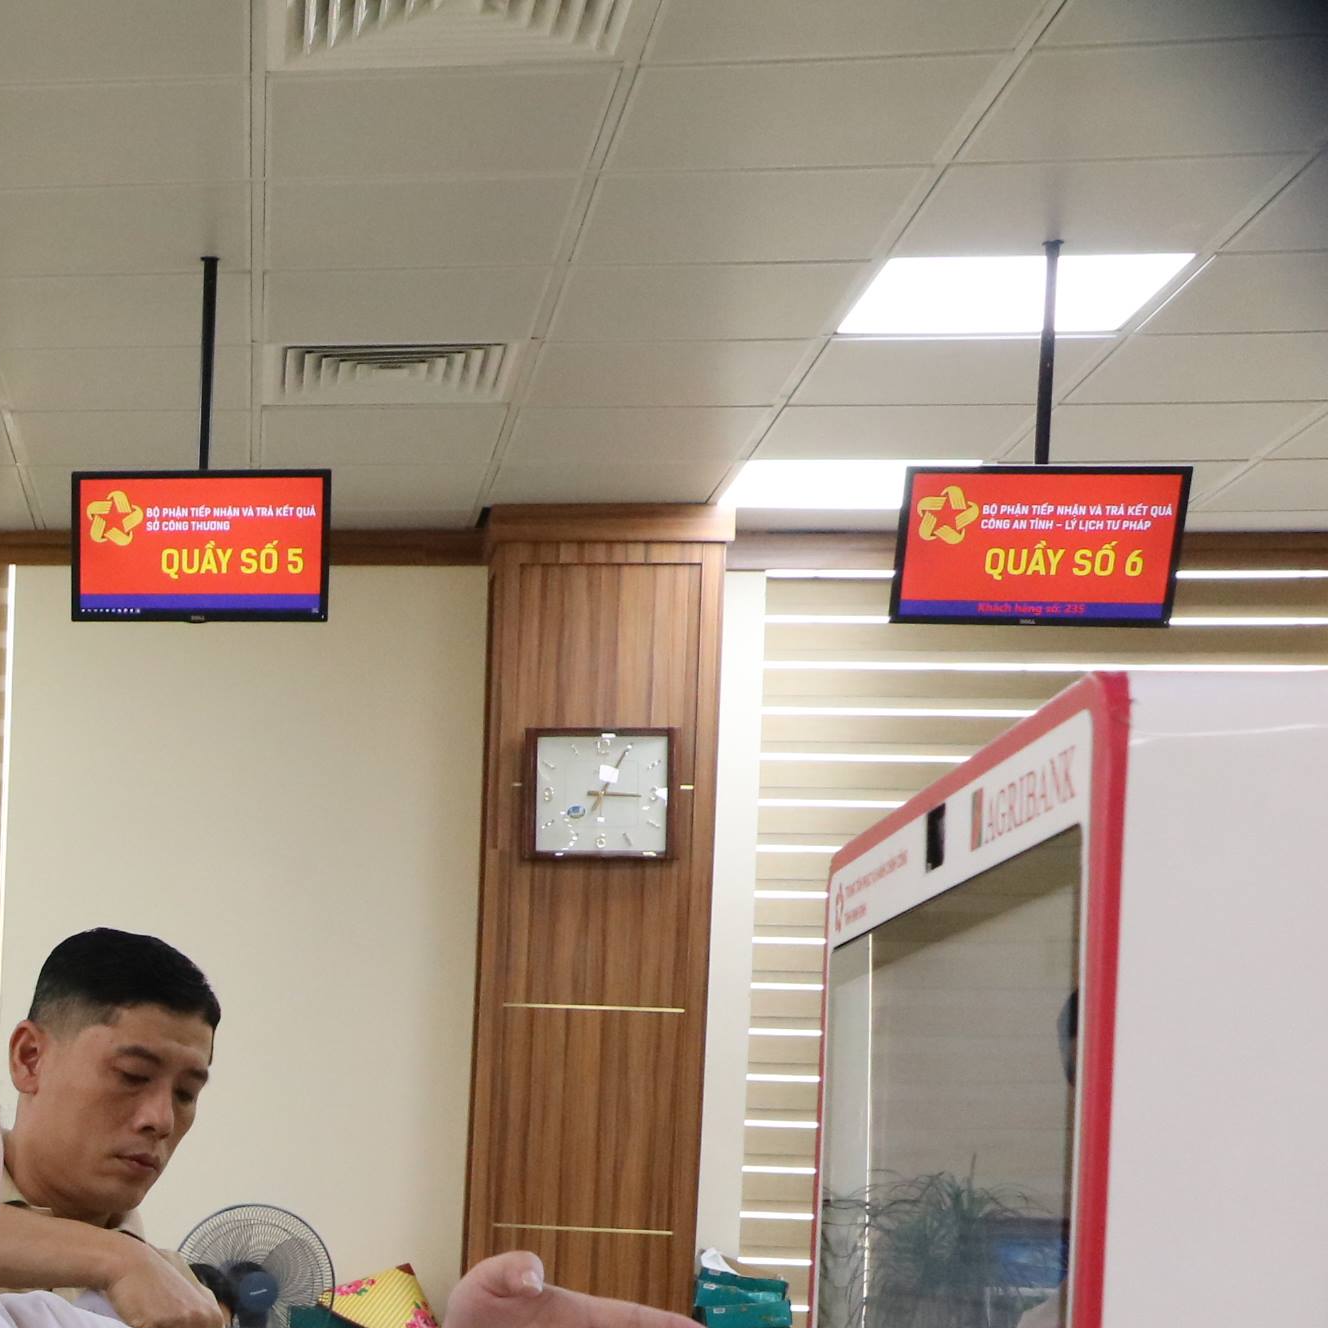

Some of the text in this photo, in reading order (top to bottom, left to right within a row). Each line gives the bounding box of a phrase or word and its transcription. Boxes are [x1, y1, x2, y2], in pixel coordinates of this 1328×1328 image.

[146, 504, 316, 520] BỘ PHẬN TIẾP NHẬN VÀ TRẢ KẾT QUẢ
[982, 502, 1172, 518] BỘ PHẬN TIẾP NHẬN VÀ TRẢ KẾT QUẢ
[161, 519, 189, 531] CÔNG
[190, 520, 231, 532] THƯƠNG
[980, 517, 1010, 529] CÔNG
[1011, 519, 1027, 529] AN
[1029, 517, 1054, 529] TỈNH
[1078, 519, 1104, 532] LỊCH
[1106, 519, 1122, 530] TƯ
[1121, 519, 1152, 531] PHÁP
[161, 539, 304, 579] QUẦY SỐ 5
[984, 540, 1144, 581] QUẦY SỐ 6
[984, 744, 1076, 844] AGRIBANK
